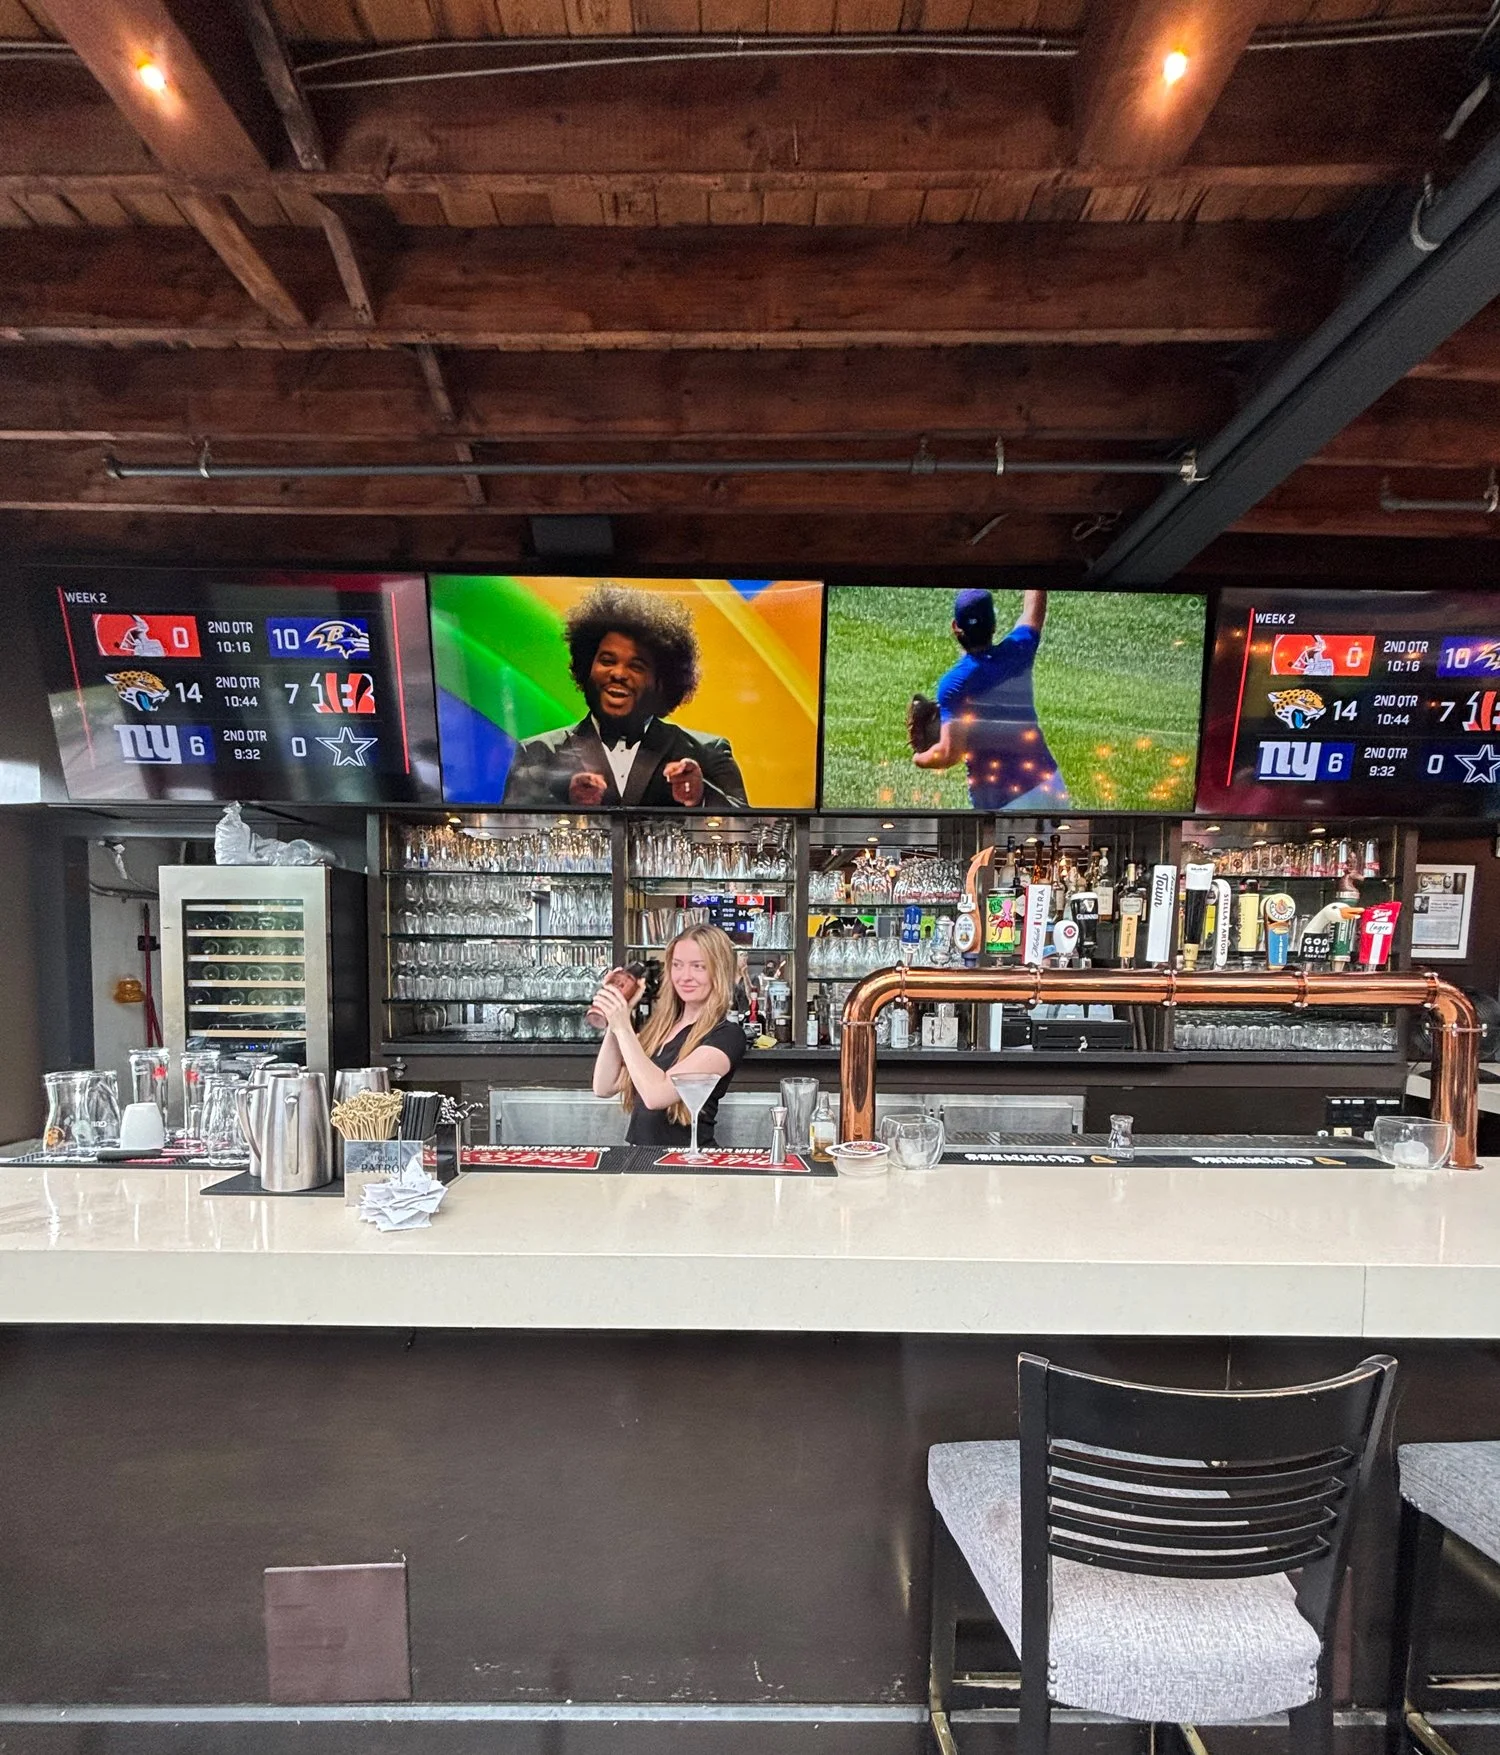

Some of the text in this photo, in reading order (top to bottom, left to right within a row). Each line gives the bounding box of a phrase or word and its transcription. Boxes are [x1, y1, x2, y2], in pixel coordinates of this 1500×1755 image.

[65, 591, 107, 604] WEEK 2
[1255, 613, 1296, 624] WEEK 2
[208, 621, 253, 635] 2ND QTR
[173, 627, 189, 649] 0
[272, 628, 299, 650] 10
[216, 641, 251, 653] 10:16
[1384, 641, 1428, 653] 2ND QTR
[1346, 647, 1363, 668] 0
[1445, 648, 1470, 669] 10
[1387, 661, 1420, 672] 10:16
[216, 676, 260, 690] 2ND QTR
[175, 682, 203, 703] 14
[285, 684, 300, 704] 7
[224, 696, 258, 708] 10:44
[1374, 695, 1418, 708] 2ND QTR
[1332, 701, 1358, 721] 14
[1440, 702, 1456, 722] 7
[1377, 714, 1410, 726] 10:44
[223, 730, 267, 744] 2ND QTR
[190, 736, 205, 757] 6
[292, 737, 307, 757] 0
[234, 748, 261, 760] 9:32
[1364, 748, 1408, 760] 2ND QTR
[1328, 753, 1343, 773] 6
[1427, 755, 1444, 774] 0
[1369, 766, 1396, 777] 9:32
[1154, 873, 1169, 908] Town
[1036, 888, 1046, 920] ULTRA
[1369, 923, 1390, 934] Lager
